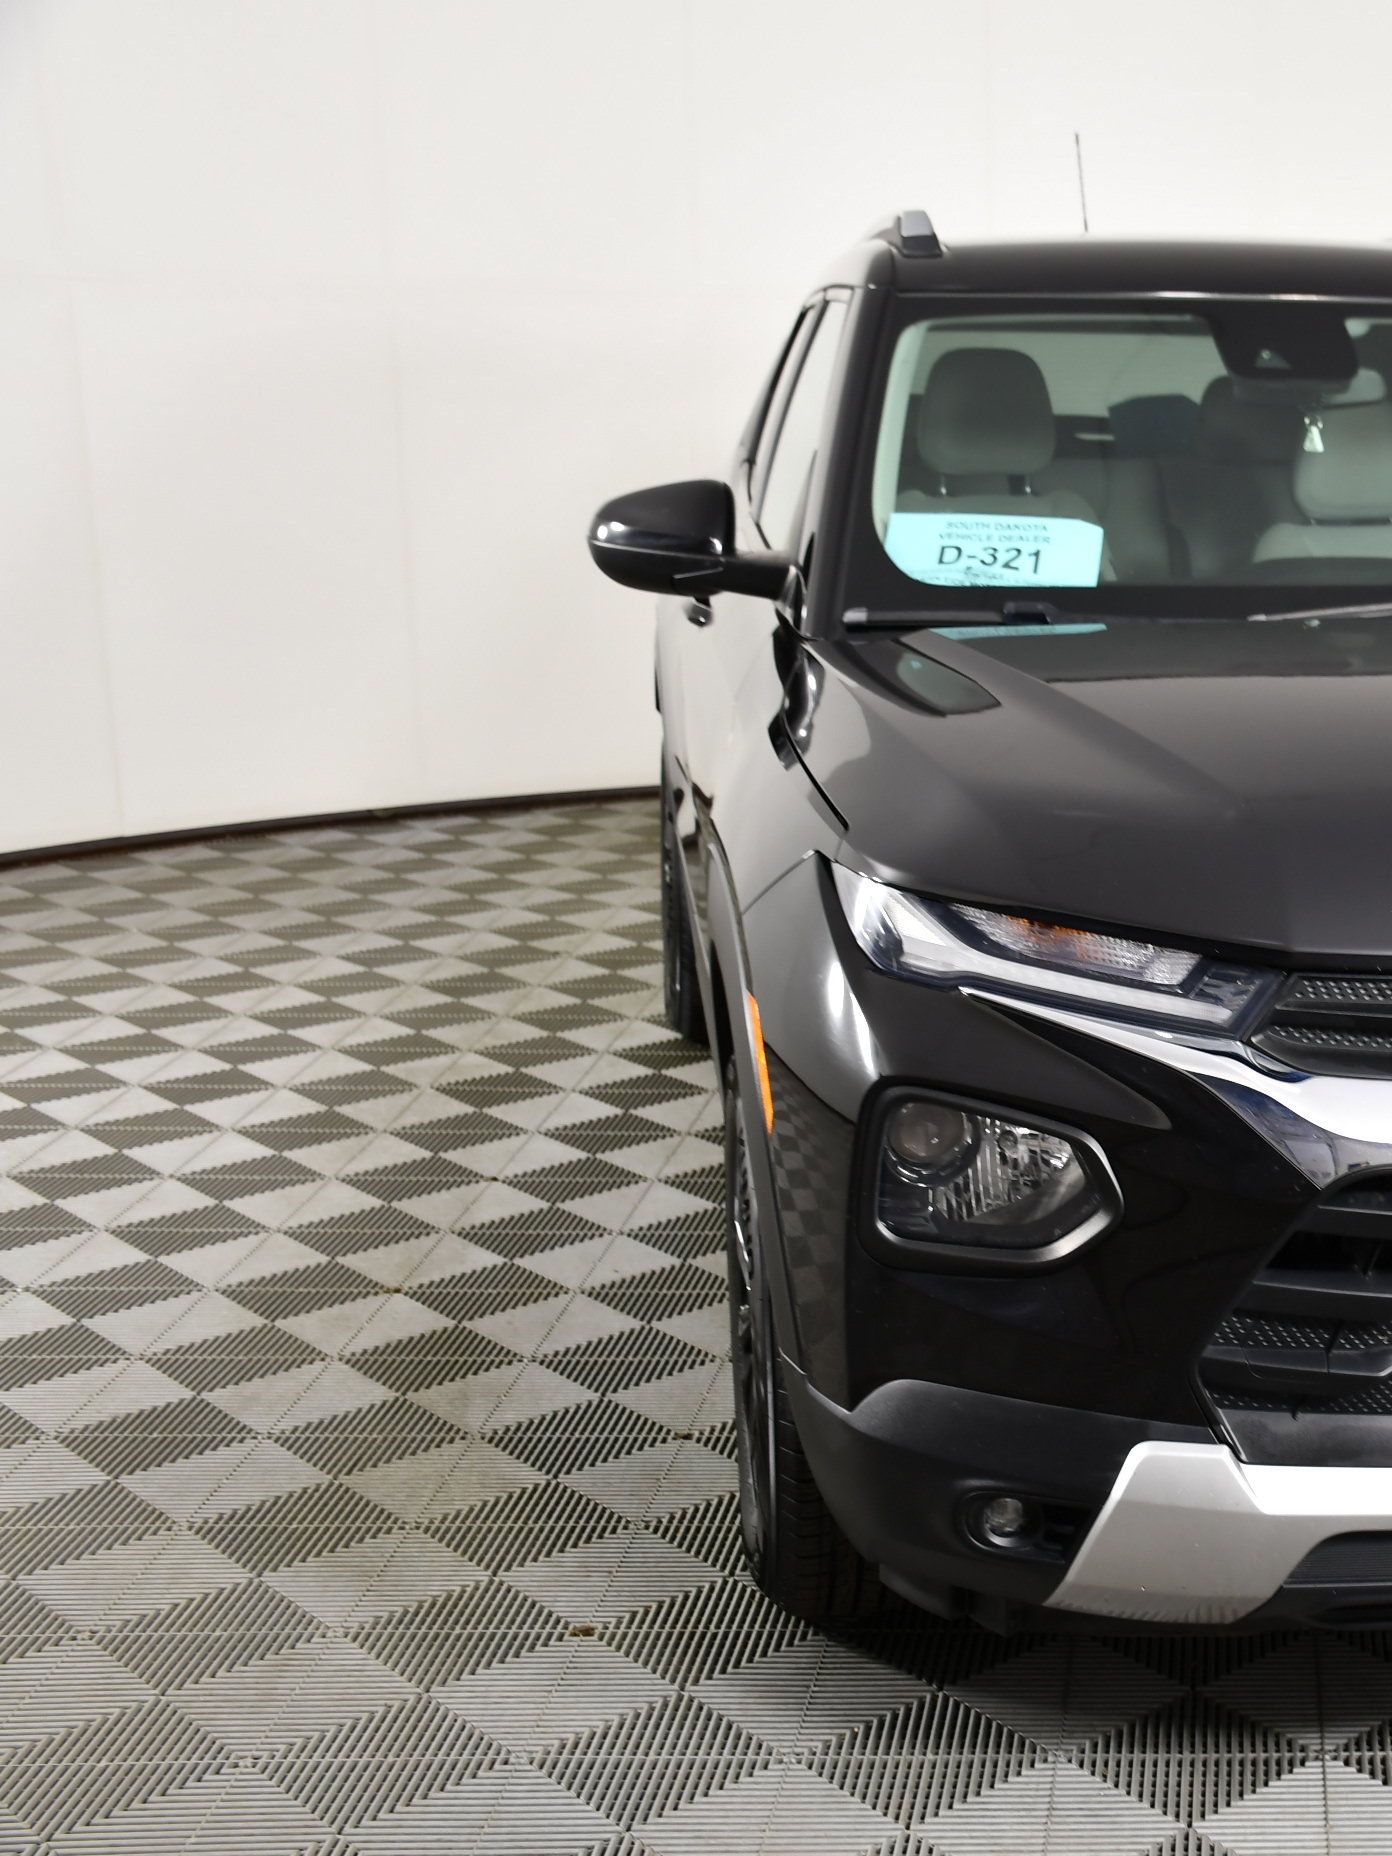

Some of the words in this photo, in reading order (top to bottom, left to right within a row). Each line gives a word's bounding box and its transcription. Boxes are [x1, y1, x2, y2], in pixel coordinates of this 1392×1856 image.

[945, 521, 991, 530] SOUTH
[994, 522, 1049, 532] DAKOTA
[939, 532, 993, 542] VEHICLE
[997, 534, 1051, 545] DEALER
[937, 545, 1041, 574] D-321
